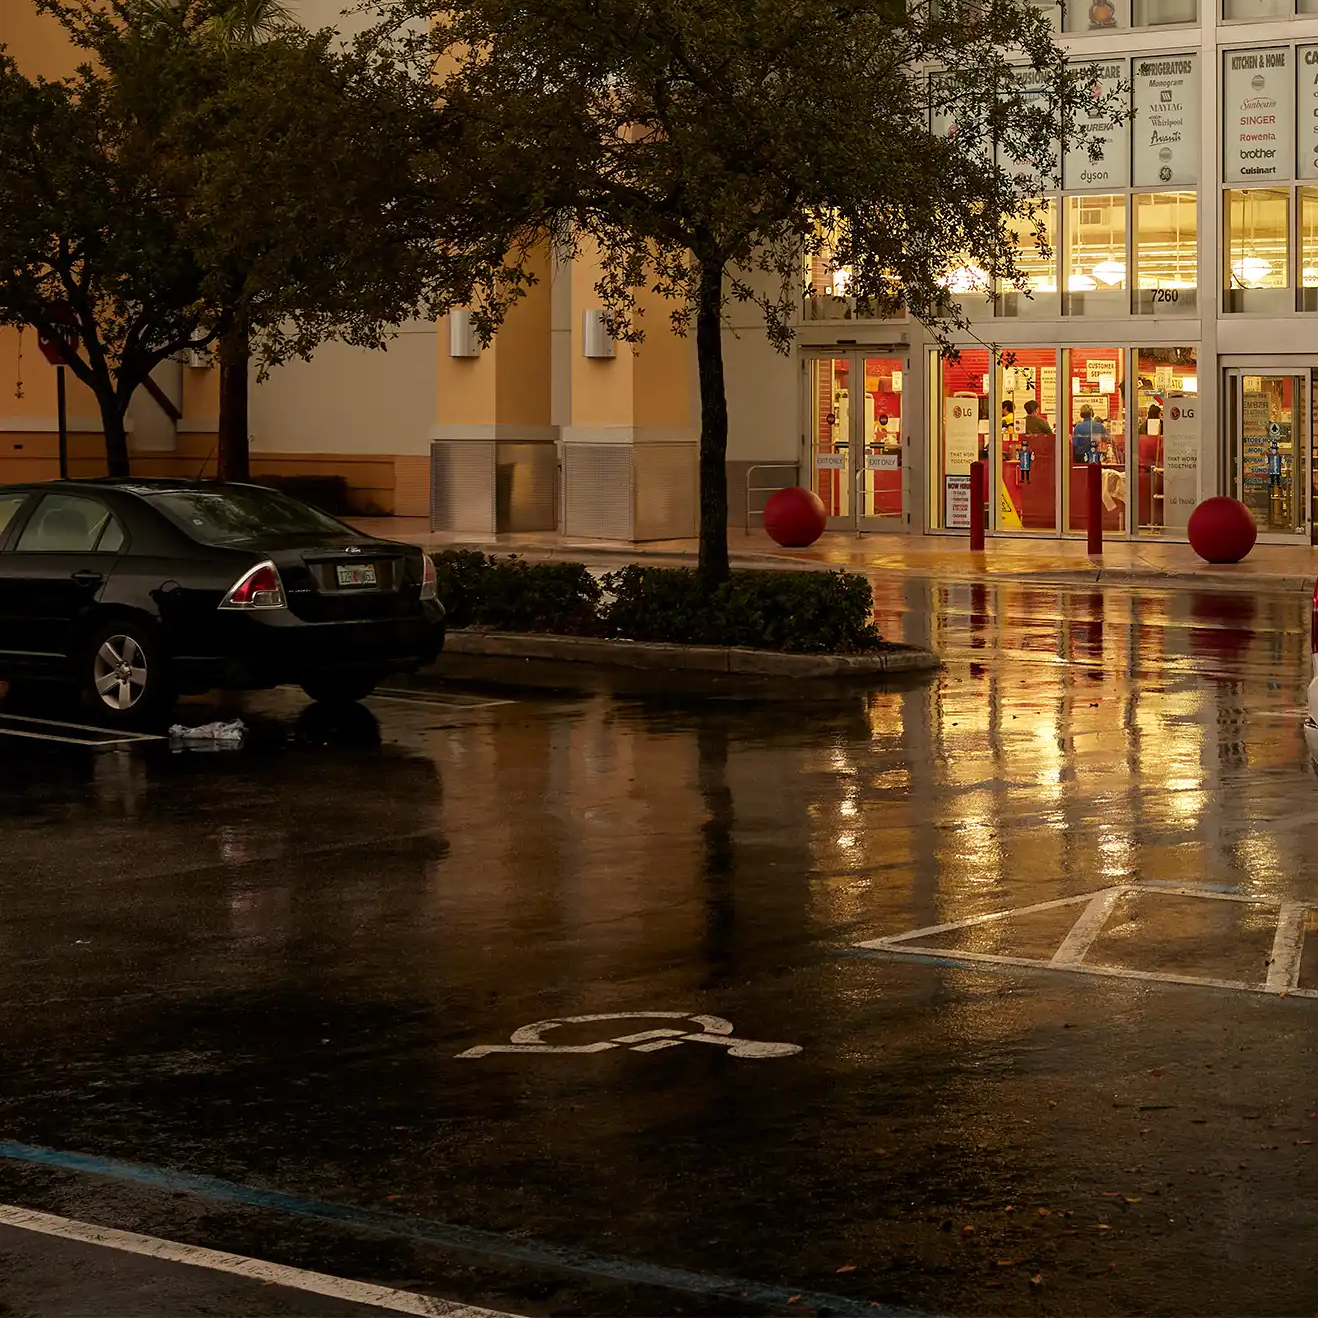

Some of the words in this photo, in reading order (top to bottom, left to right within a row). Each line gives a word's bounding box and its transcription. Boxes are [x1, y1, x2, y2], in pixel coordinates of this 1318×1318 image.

[1231, 55, 1258, 70] KITCHEN
[1258, 55, 1265, 68] &
[1265, 53, 1285, 68] HOME
[1148, 79, 1184, 88] Monogram
[1149, 103, 1183, 112] MAYTAG
[1240, 98, 1277, 111] Sunbeam
[1150, 117, 1183, 128] Whirlpool
[1240, 115, 1276, 125] SINGER
[1240, 132, 1276, 142] Rowenta
[1240, 149, 1276, 159] brother
[1240, 166, 1276, 175] Cuisinart
[1080, 169, 1109, 183] dyson
[1151, 289, 1179, 302] 7260
[1087, 362, 1115, 370] CUSTOMER
[963, 408, 972, 417] LG
[1182, 408, 1195, 418] LG
